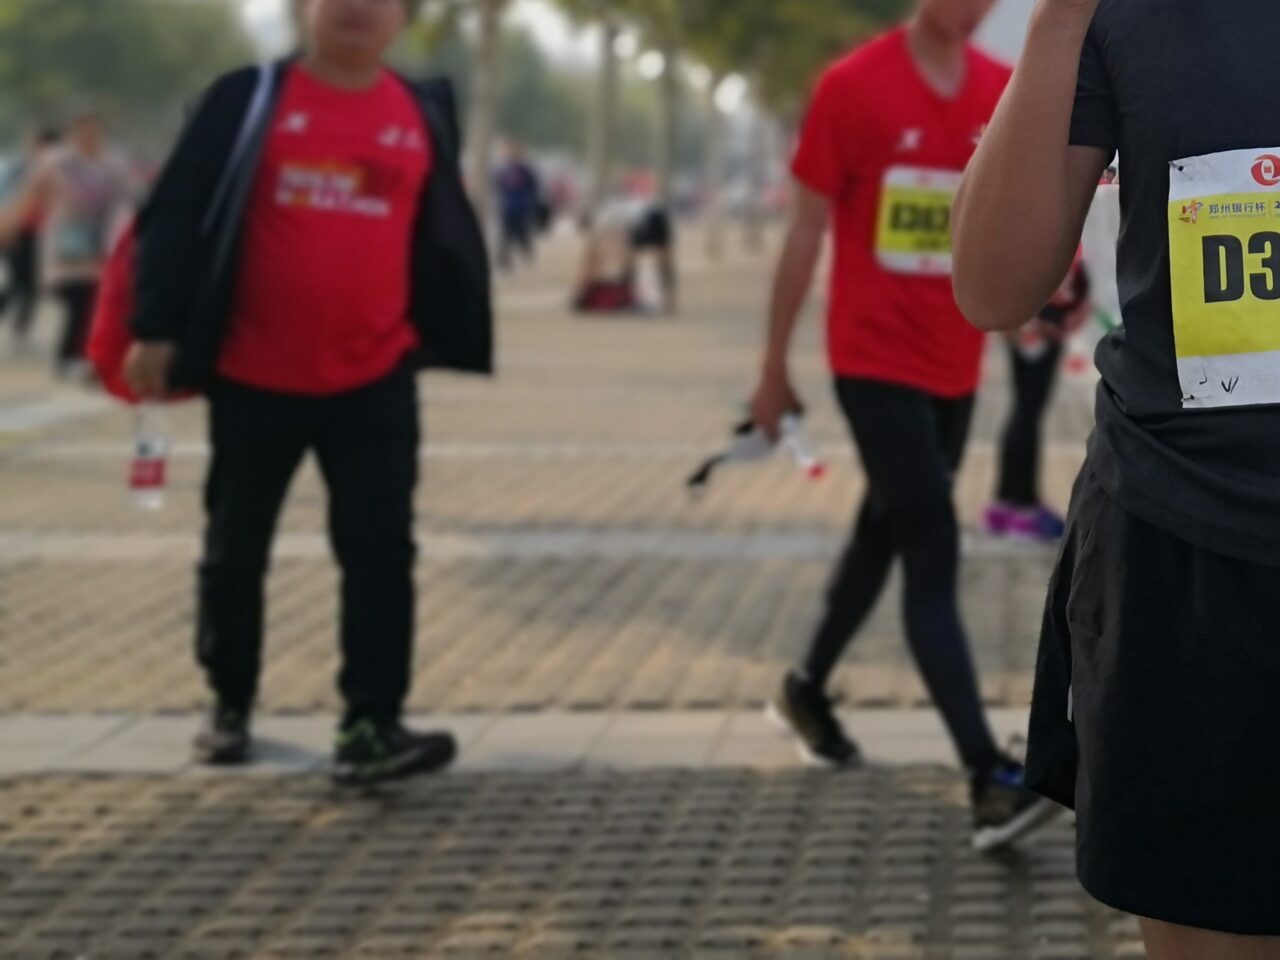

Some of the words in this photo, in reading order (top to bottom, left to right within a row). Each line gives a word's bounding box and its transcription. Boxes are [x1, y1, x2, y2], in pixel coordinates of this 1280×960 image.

[1208, 202, 1265, 214] 郑州银行杯
